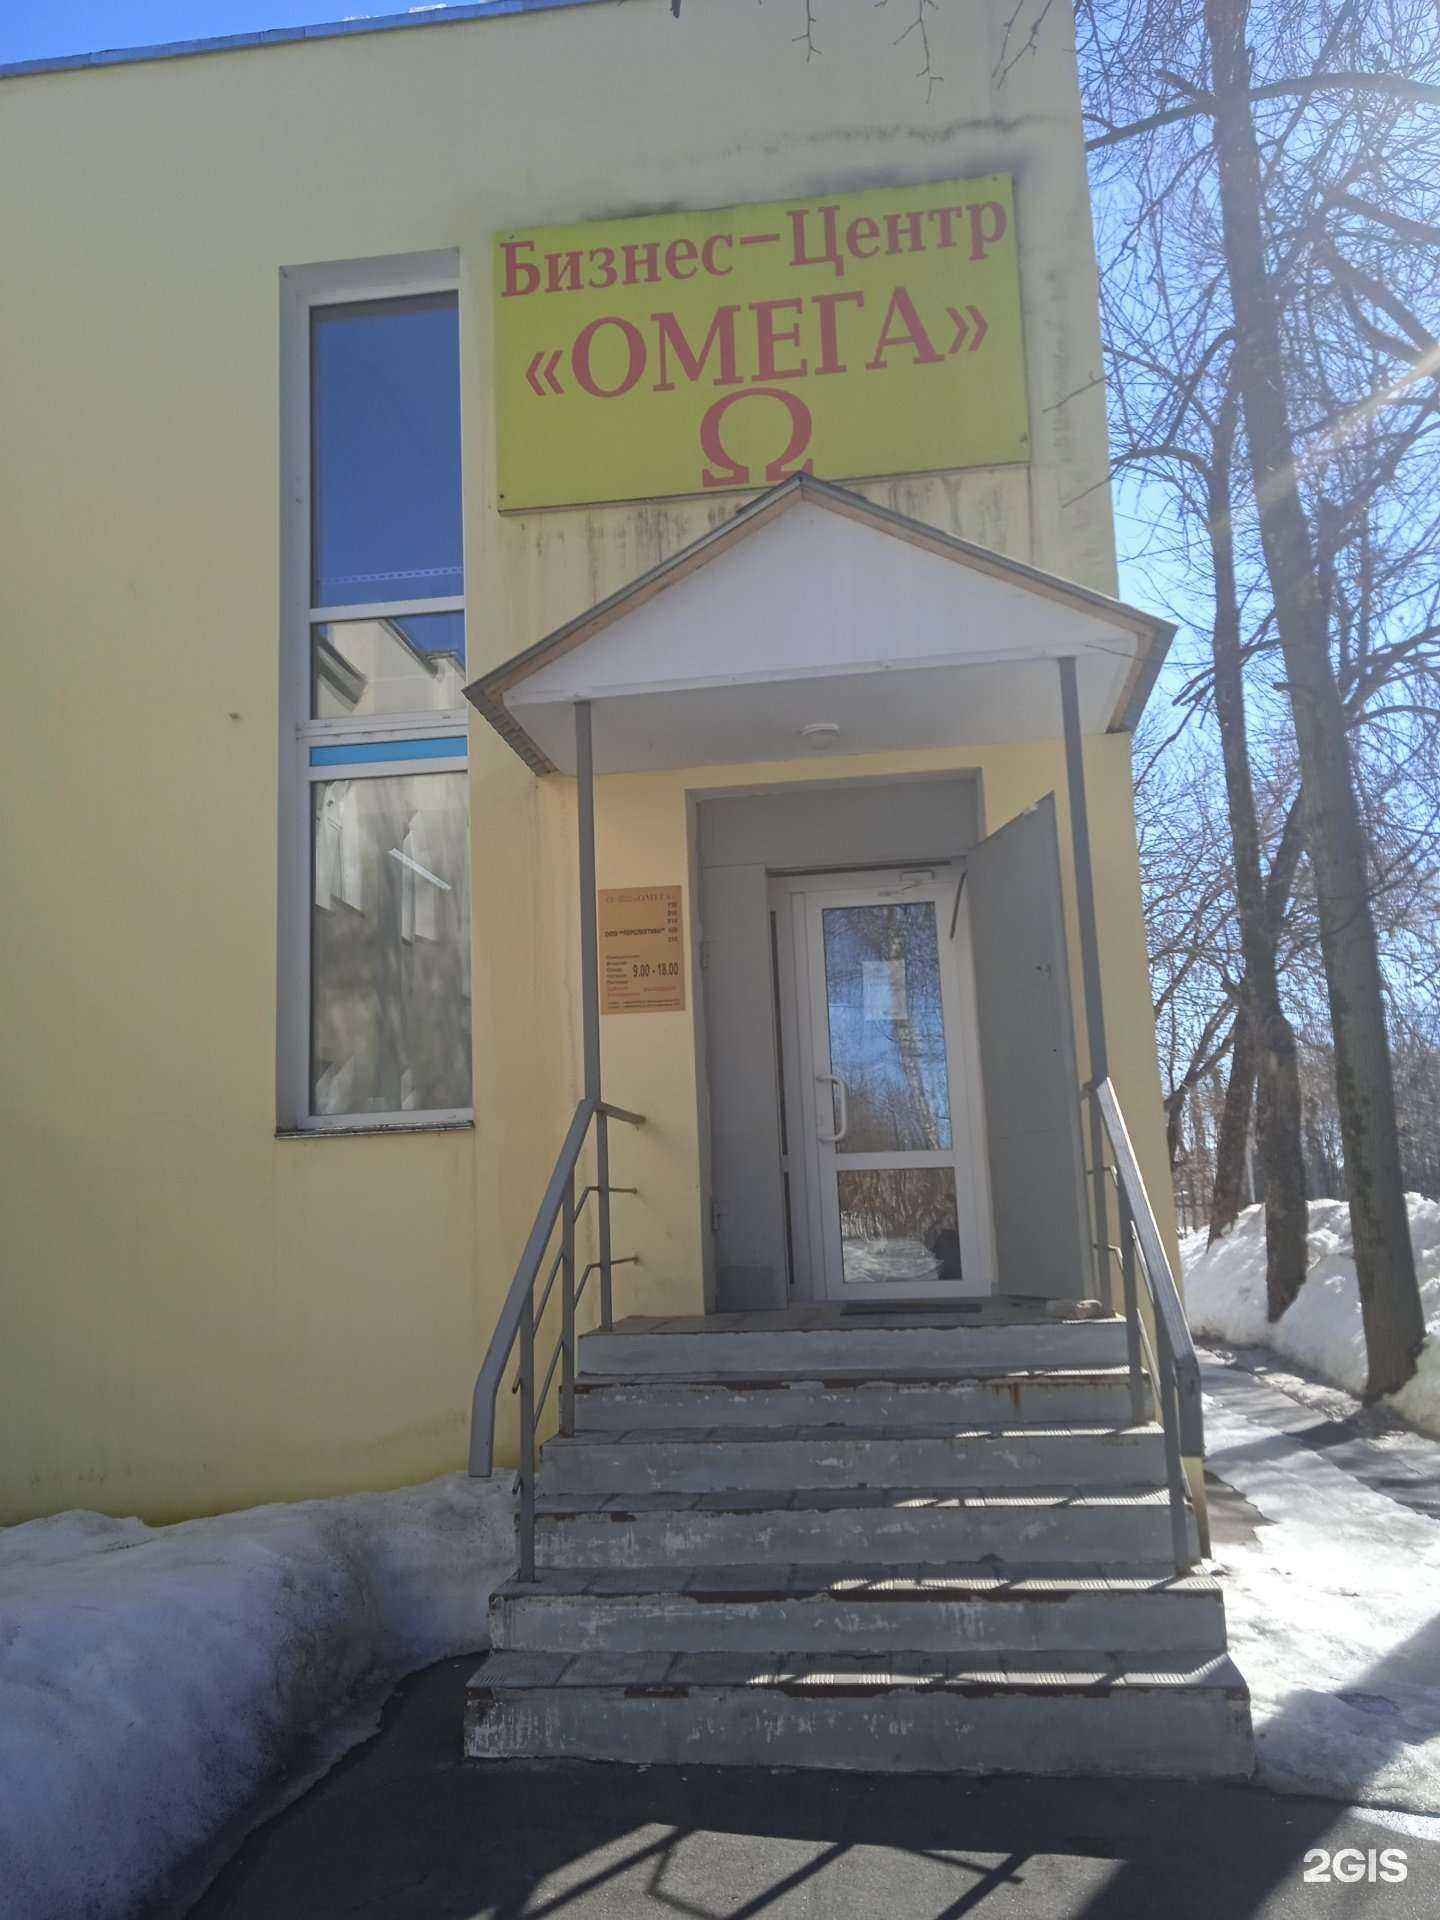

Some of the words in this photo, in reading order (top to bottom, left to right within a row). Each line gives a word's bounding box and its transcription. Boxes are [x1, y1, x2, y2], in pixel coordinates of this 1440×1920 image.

[524, 286, 989, 398] «ОМЕГА»
[632, 963, 650, 978] 9.00
[657, 961, 679, 976] 18.00
